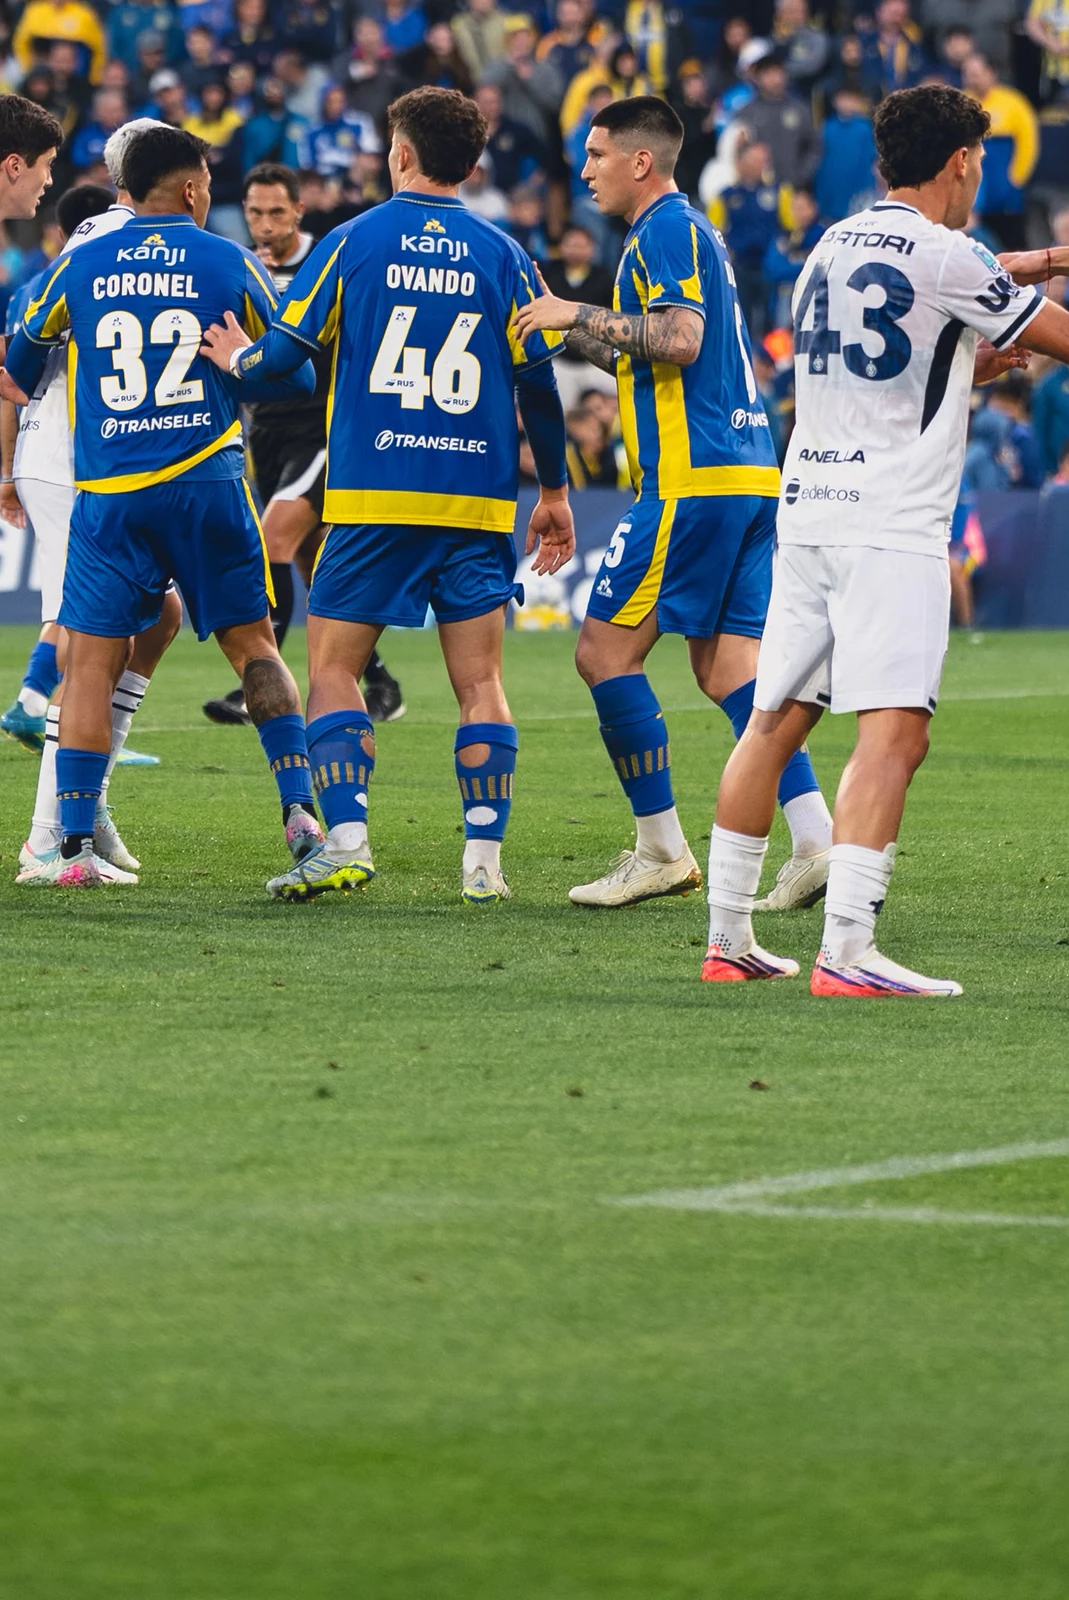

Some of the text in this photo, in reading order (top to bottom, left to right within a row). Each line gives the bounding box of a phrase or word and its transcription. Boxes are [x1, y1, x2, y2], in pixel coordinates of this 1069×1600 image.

[116, 245, 186, 266] kanji
[401, 234, 468, 261] kanji
[93, 272, 199, 300] CORONEL
[386, 264, 475, 297] OVANDO
[793, 256, 915, 381] 43
[96, 309, 204, 411] 32
[369, 306, 482, 414] 46
[176, 388, 192, 398] RUS
[397, 379, 414, 388] RUS
[121, 395, 137, 403] RUS
[453, 398, 469, 406] RUS
[119, 413, 211, 434] TRANSELEC
[395, 434, 487, 454] TRANSELEC
[802, 485, 860, 502] edelcos
